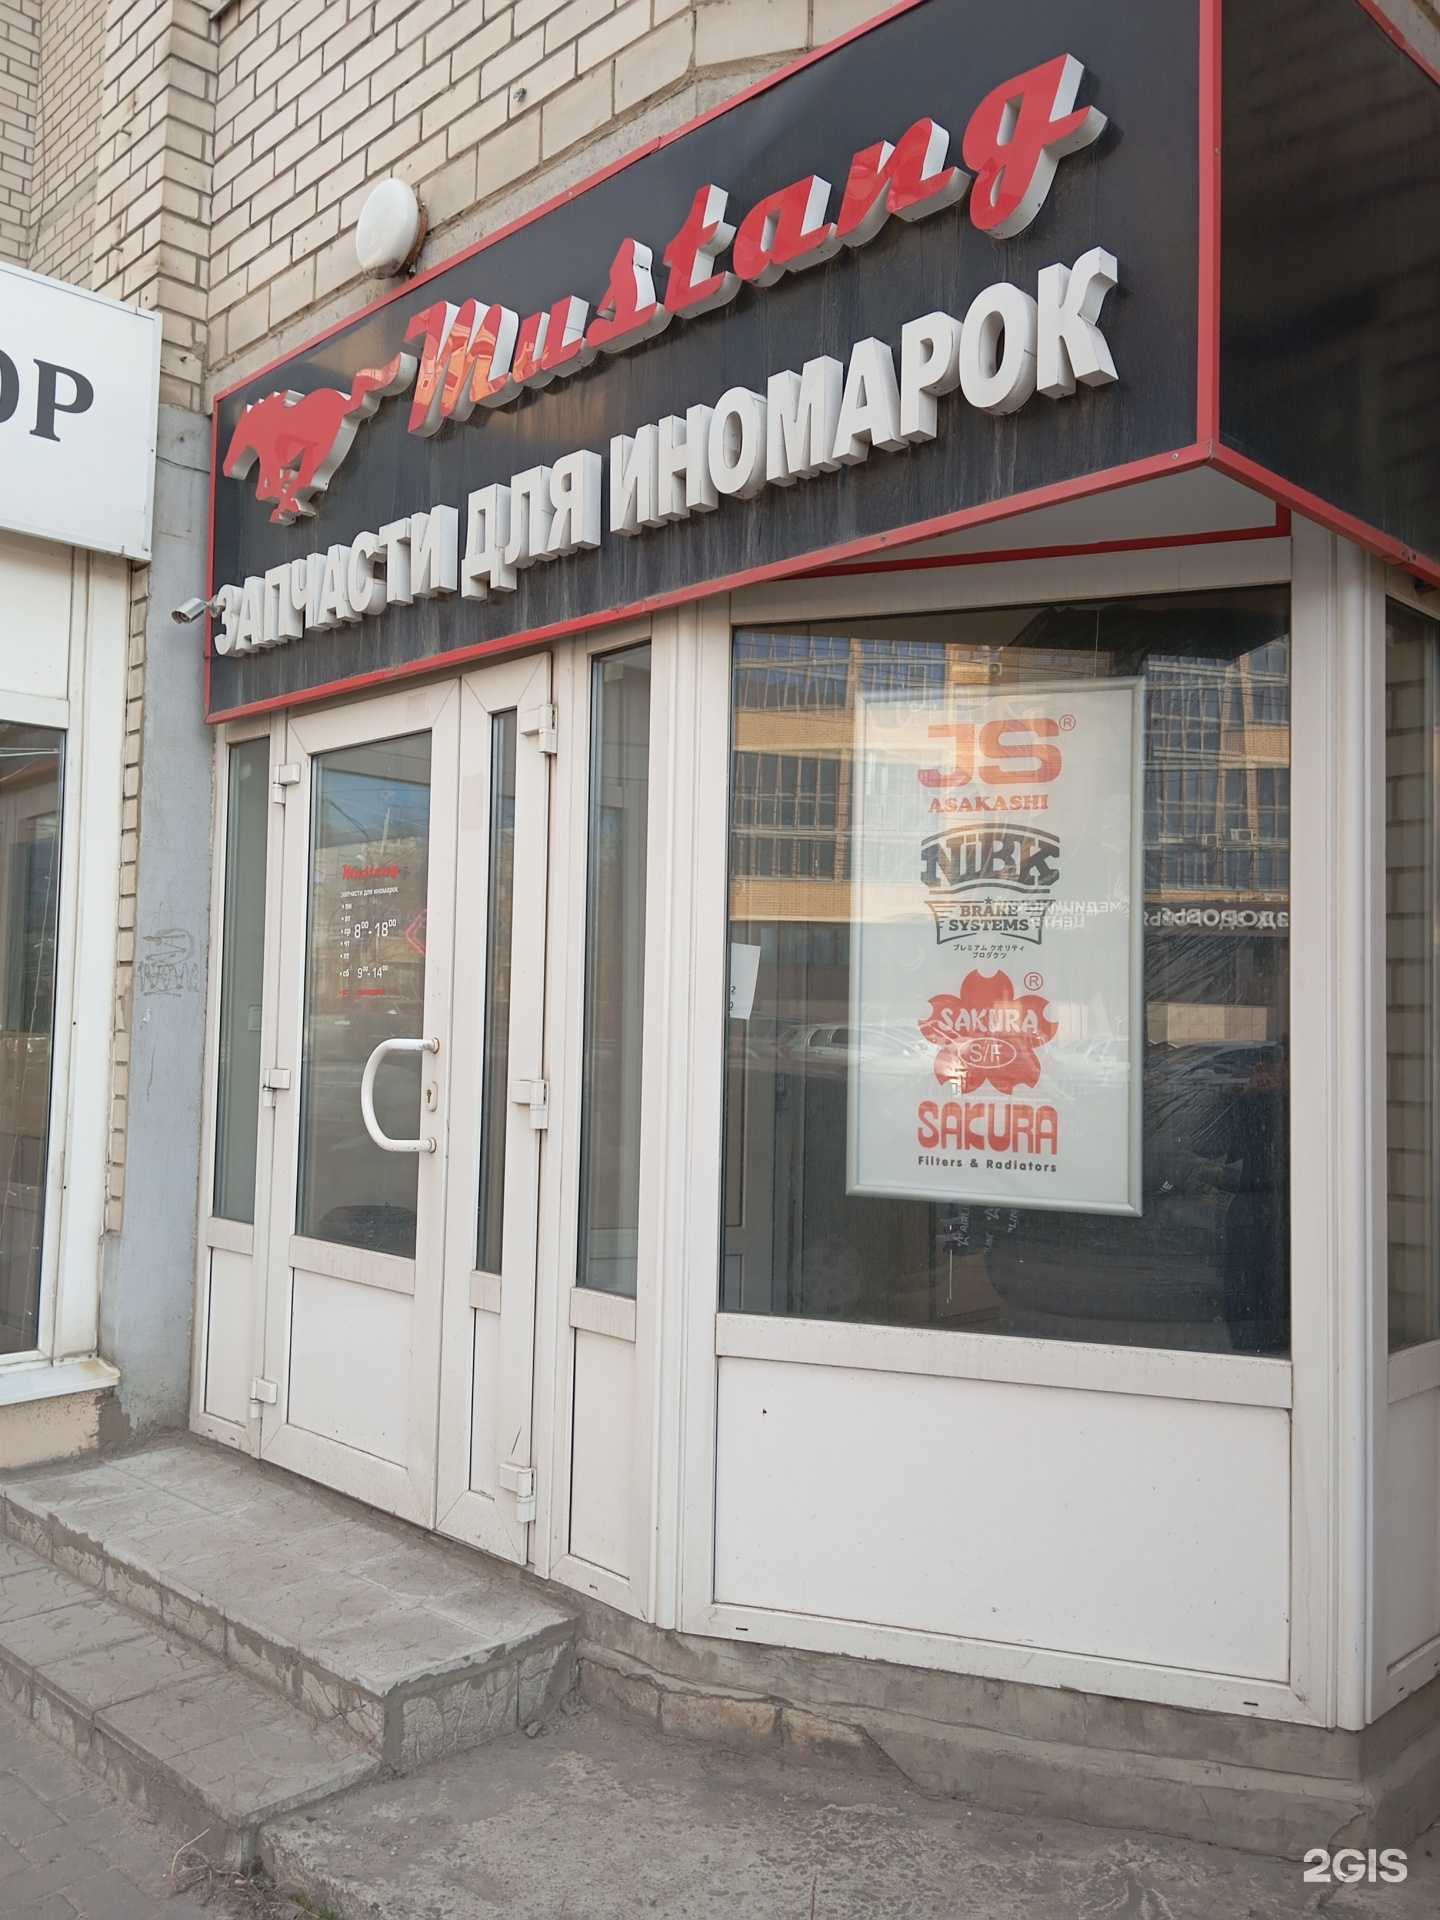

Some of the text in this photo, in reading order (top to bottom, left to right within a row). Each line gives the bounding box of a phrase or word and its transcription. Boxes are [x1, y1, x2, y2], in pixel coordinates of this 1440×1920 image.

[403, 52, 1108, 437] Mustang
[214, 247, 1118, 657] ЗАПЧАСТИ ДЛЯ ИНОМАРОК
[918, 718, 1062, 787] JS
[928, 794, 1048, 813] ASAKASHI
[960, 905, 1018, 917] BRAKE
[949, 919, 1029, 931] SYSTEMS
[939, 1008, 1040, 1033] SAKURA
[917, 1100, 1058, 1155] SAKURA
[918, 1156, 1057, 1172] Filters & Radiators
